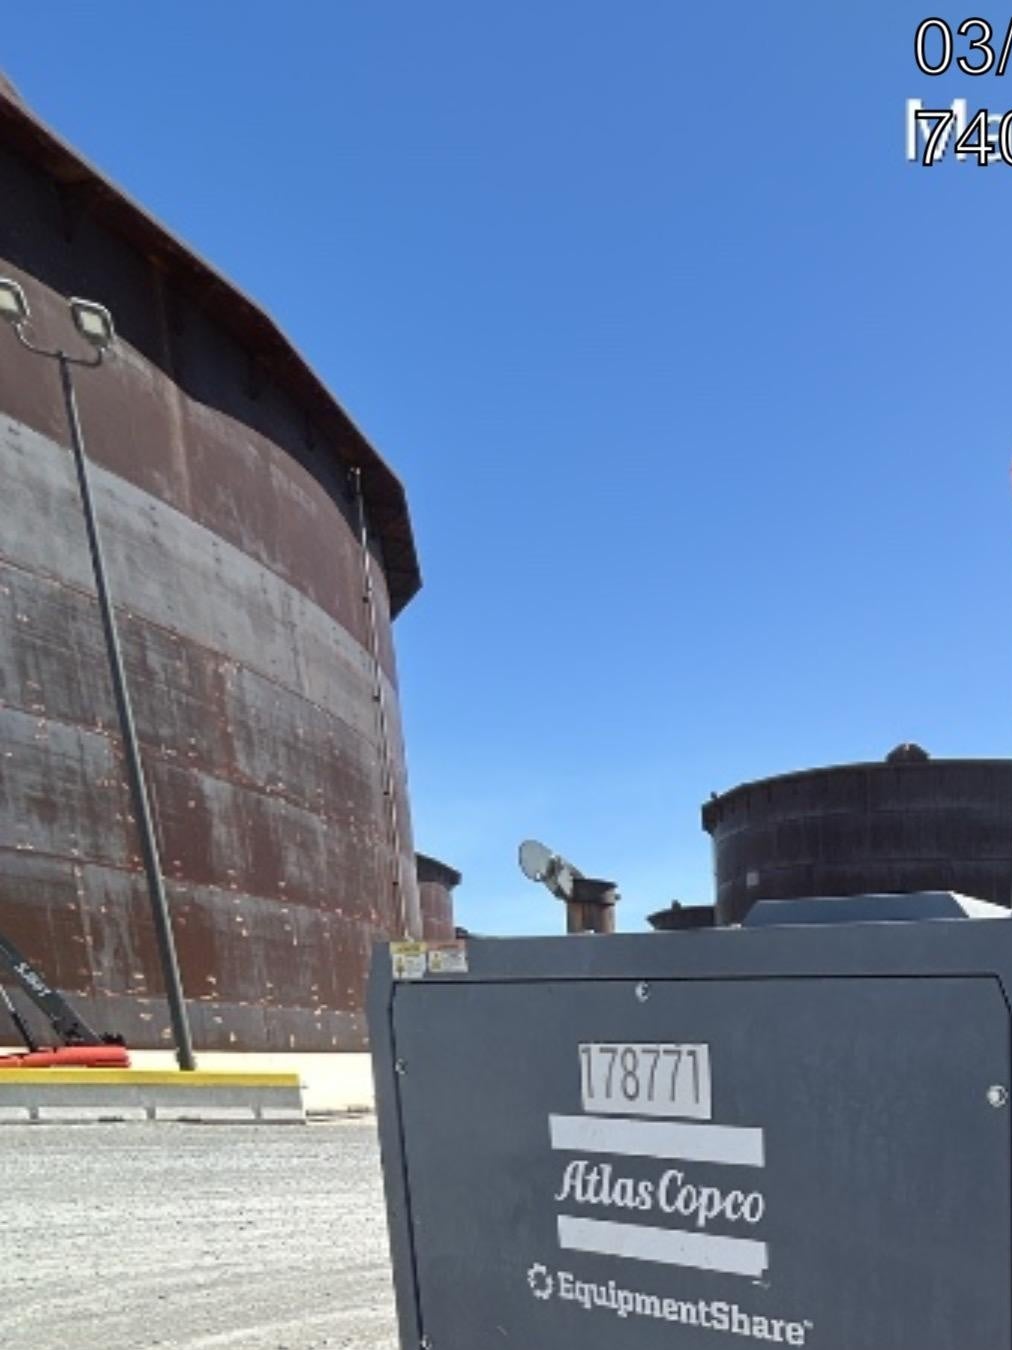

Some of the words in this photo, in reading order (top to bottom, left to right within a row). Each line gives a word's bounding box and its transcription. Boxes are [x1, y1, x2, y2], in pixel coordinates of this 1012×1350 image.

[580, 1046, 701, 1105] 178771
[555, 1160, 655, 1211] Atlas
[657, 1168, 766, 1228] Copco
[556, 1270, 808, 1345] EquipmentShare
